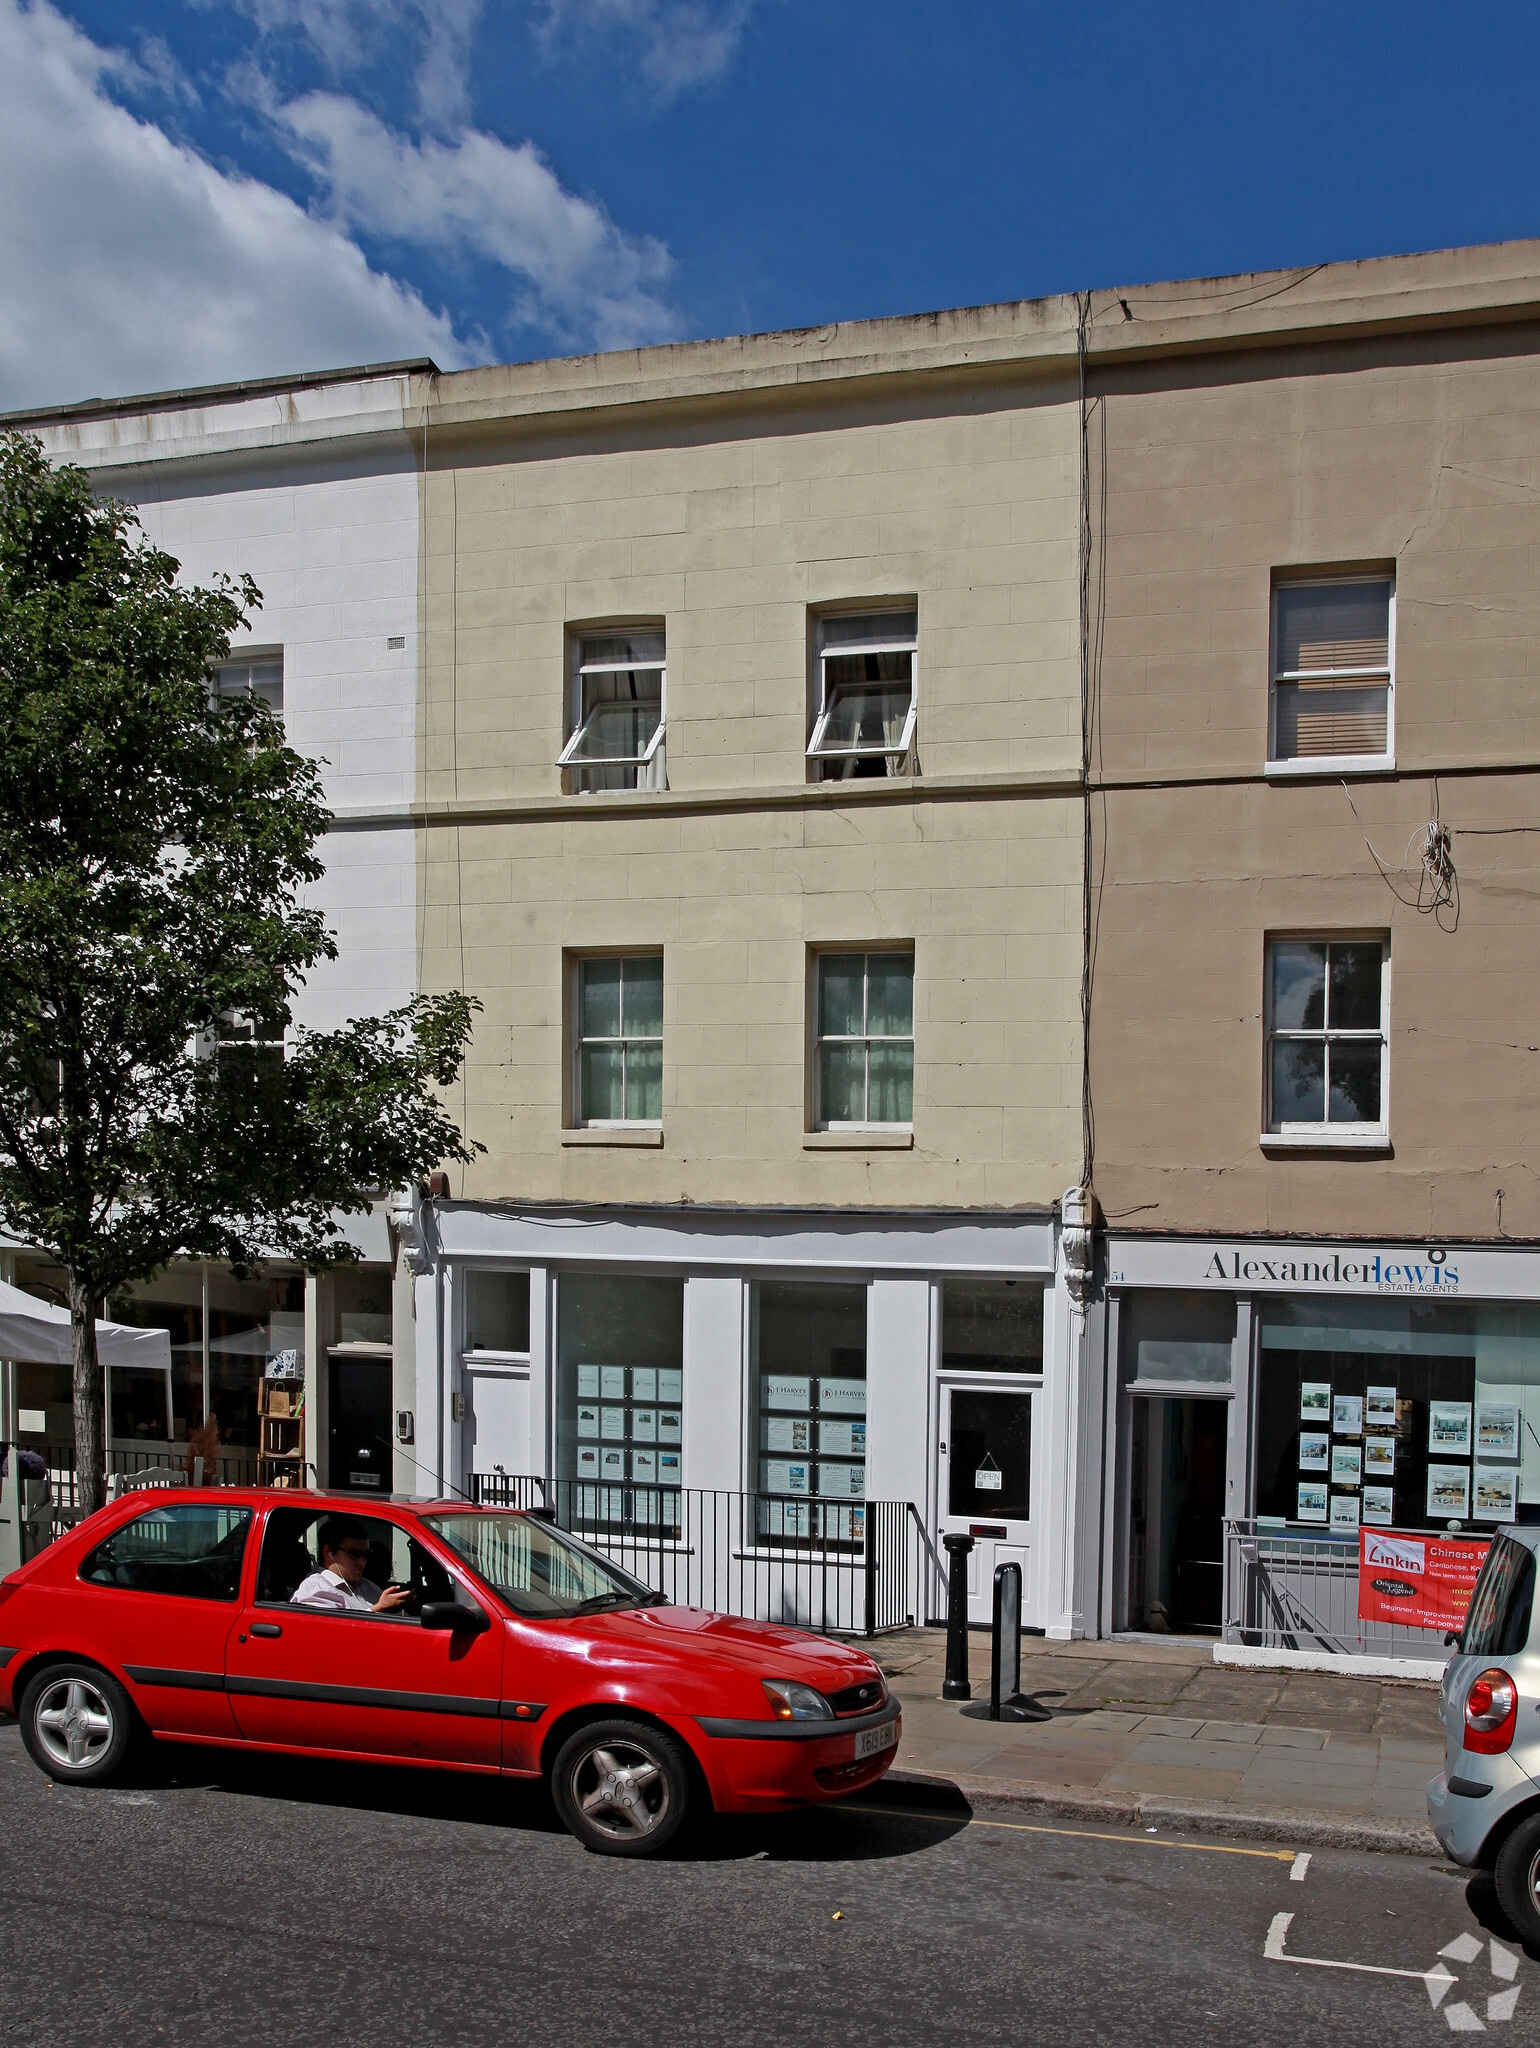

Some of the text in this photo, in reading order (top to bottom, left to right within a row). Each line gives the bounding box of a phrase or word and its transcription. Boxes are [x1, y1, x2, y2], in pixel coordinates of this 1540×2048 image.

[1377, 1283, 1459, 1293] ESTATE AGENTS
[977, 1472, 1000, 1481] OPEN
[1368, 1545, 1421, 1571] Linkin
[1430, 1547, 1475, 1560] Chinese
[1429, 1560, 1469, 1572] Cantonese,
[1429, 1570, 1442, 1578] New
[1388, 1585, 1414, 1596] Legend
[1380, 1602, 1465, 1622] Beginner, Improvement
[1423, 1617, 1437, 1626] For
[1437, 1621, 1454, 1629] both
